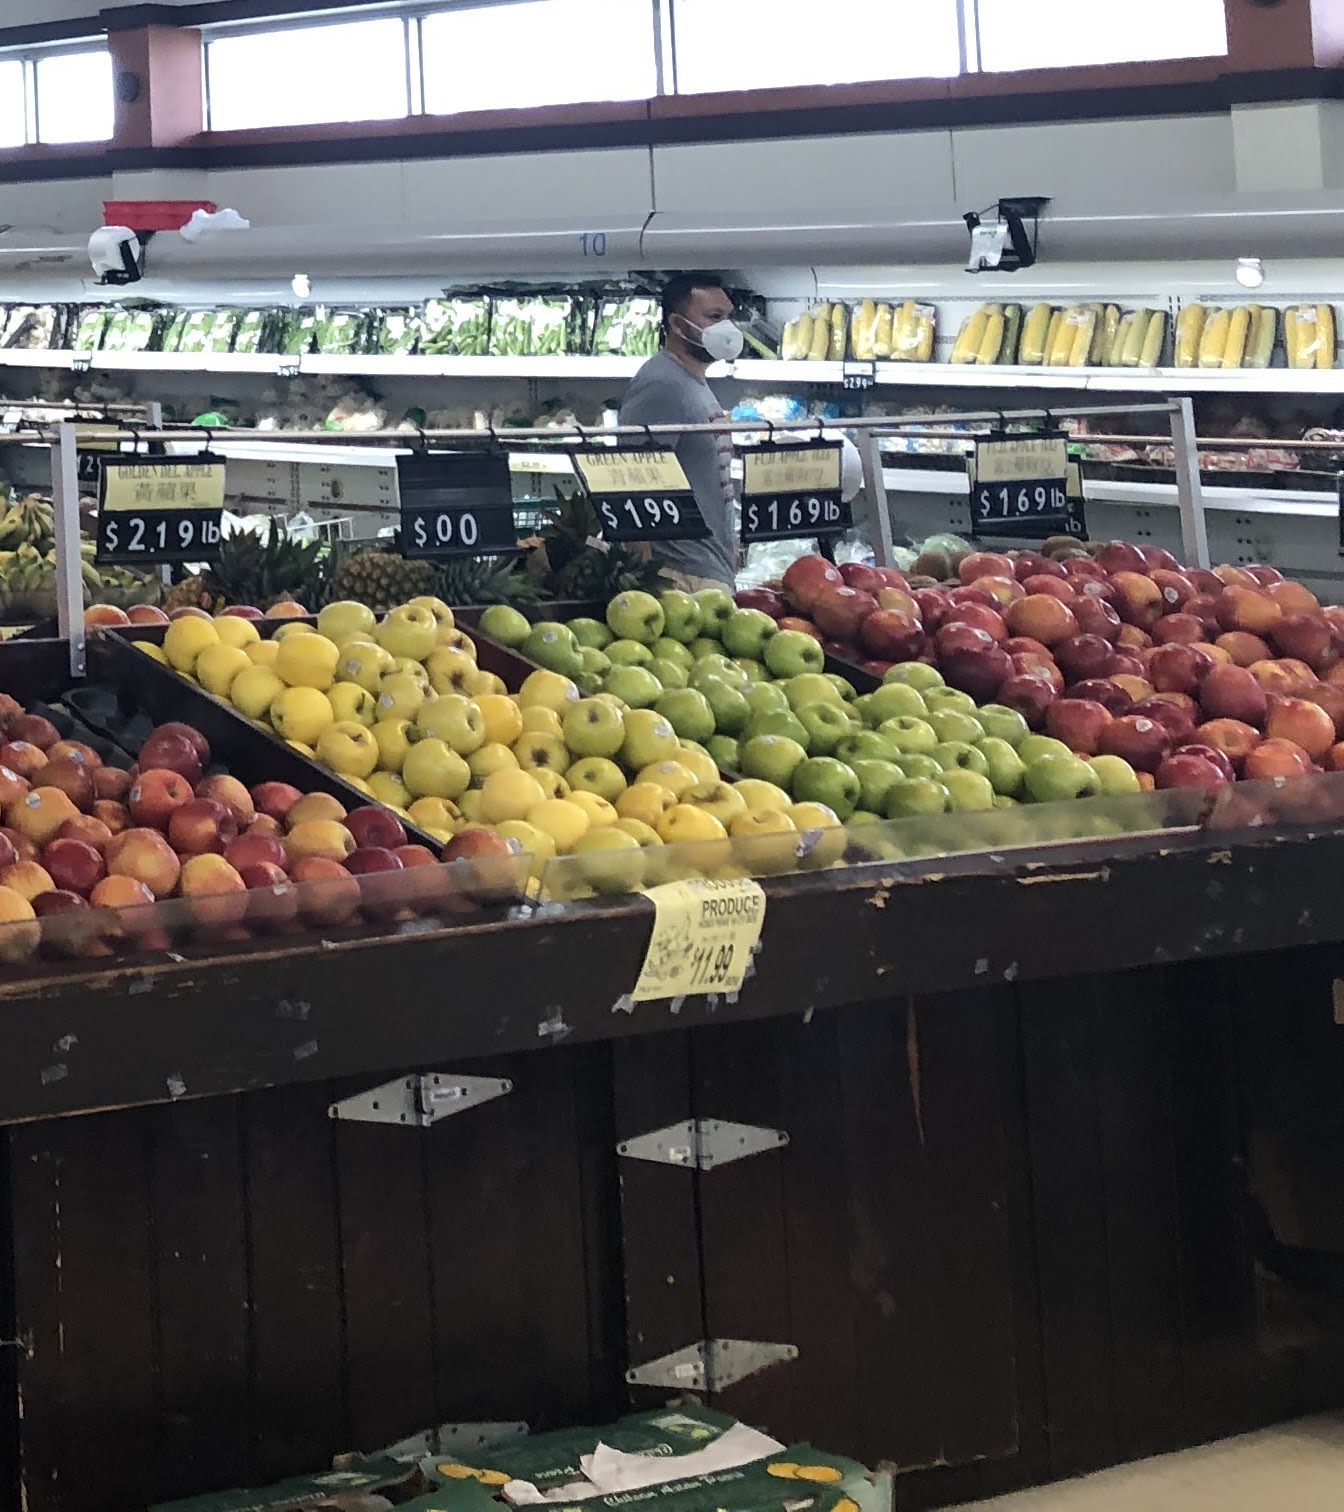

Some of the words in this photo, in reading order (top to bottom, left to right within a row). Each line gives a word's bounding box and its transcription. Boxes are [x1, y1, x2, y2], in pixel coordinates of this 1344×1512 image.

[578, 232, 606, 257] 10
[1051, 488, 1066, 508] lb
[824, 500, 840, 521] lb
[201, 520, 220, 544] lb
[702, 895, 759, 918] PRODUCE
